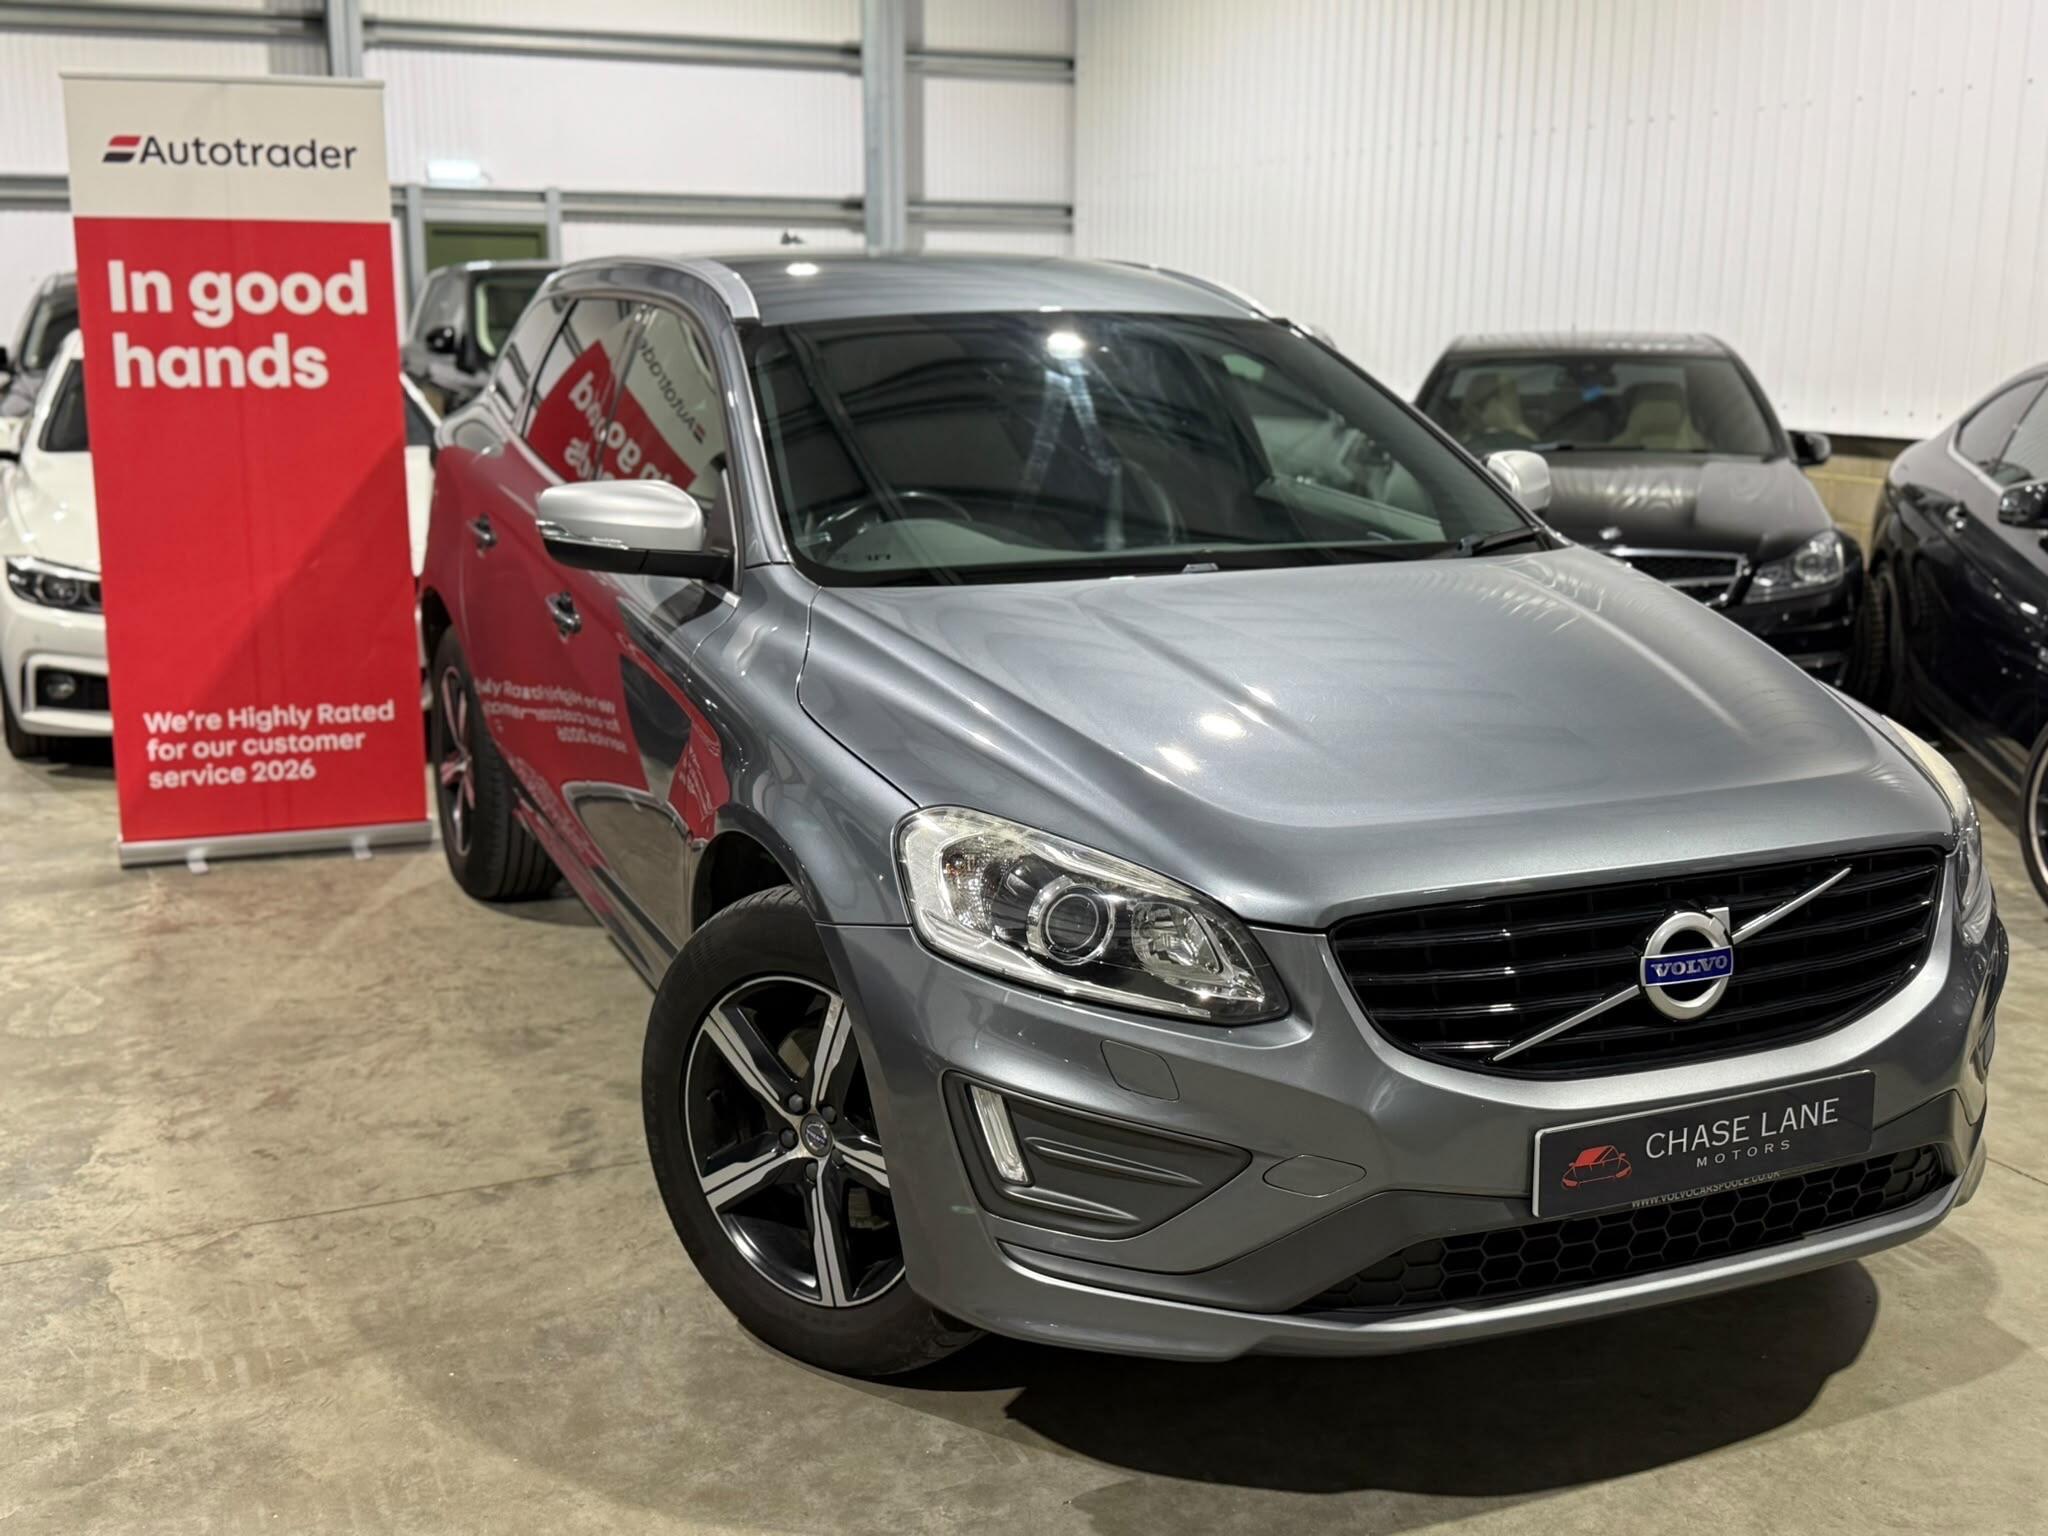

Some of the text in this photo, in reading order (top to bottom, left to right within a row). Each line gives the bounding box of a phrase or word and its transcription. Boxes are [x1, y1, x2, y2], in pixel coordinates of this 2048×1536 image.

[139, 136, 358, 169] Autotrader
[108, 259, 368, 329] In good
[112, 332, 330, 390] hands
[143, 700, 395, 734] We're Highly Rated
[146, 731, 366, 762] for our customer
[148, 759, 316, 790] service 2026
[1650, 955, 1728, 977] VOLVO
[1646, 1098, 1840, 1159] CHASE LANE
[1696, 1140, 1792, 1168] MOTORS
